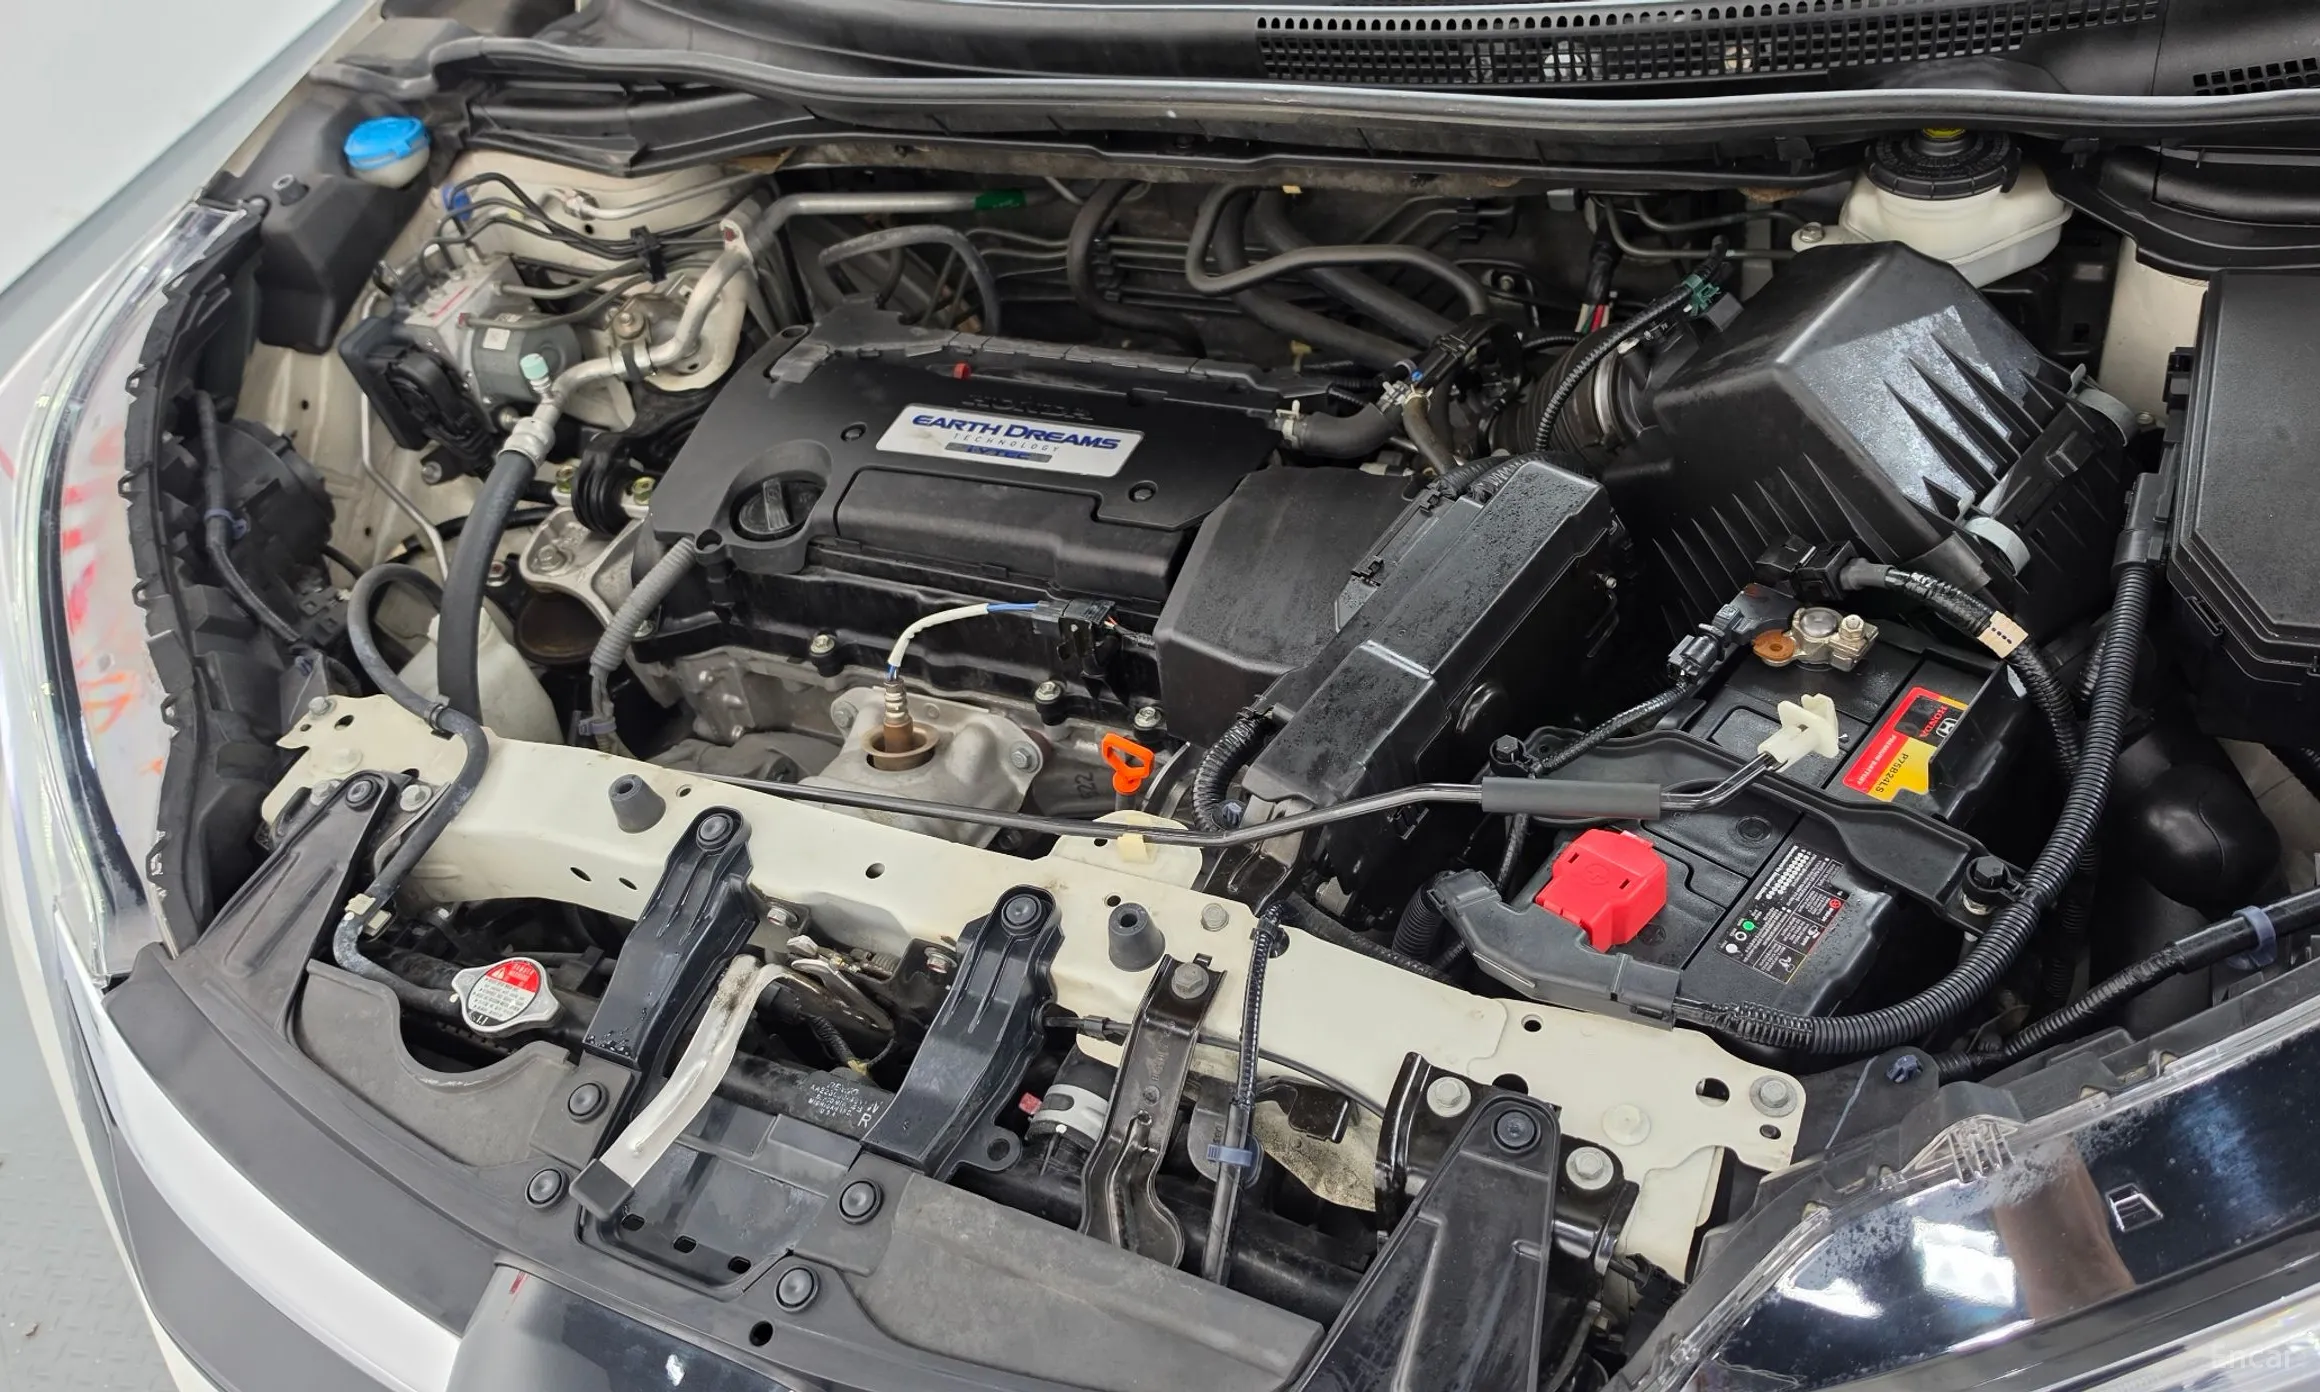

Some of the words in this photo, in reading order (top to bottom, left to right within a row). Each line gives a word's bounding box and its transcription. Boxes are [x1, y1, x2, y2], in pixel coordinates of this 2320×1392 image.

[911, 414, 1003, 436] EARTH
[1005, 424, 1121, 450] DREAMS
[952, 433, 1060, 452] TECHNOLOGY
[1919, 705, 1948, 738] HONDA
[1875, 753, 1909, 793] P75B24LS
[857, 1113, 872, 1128] R
